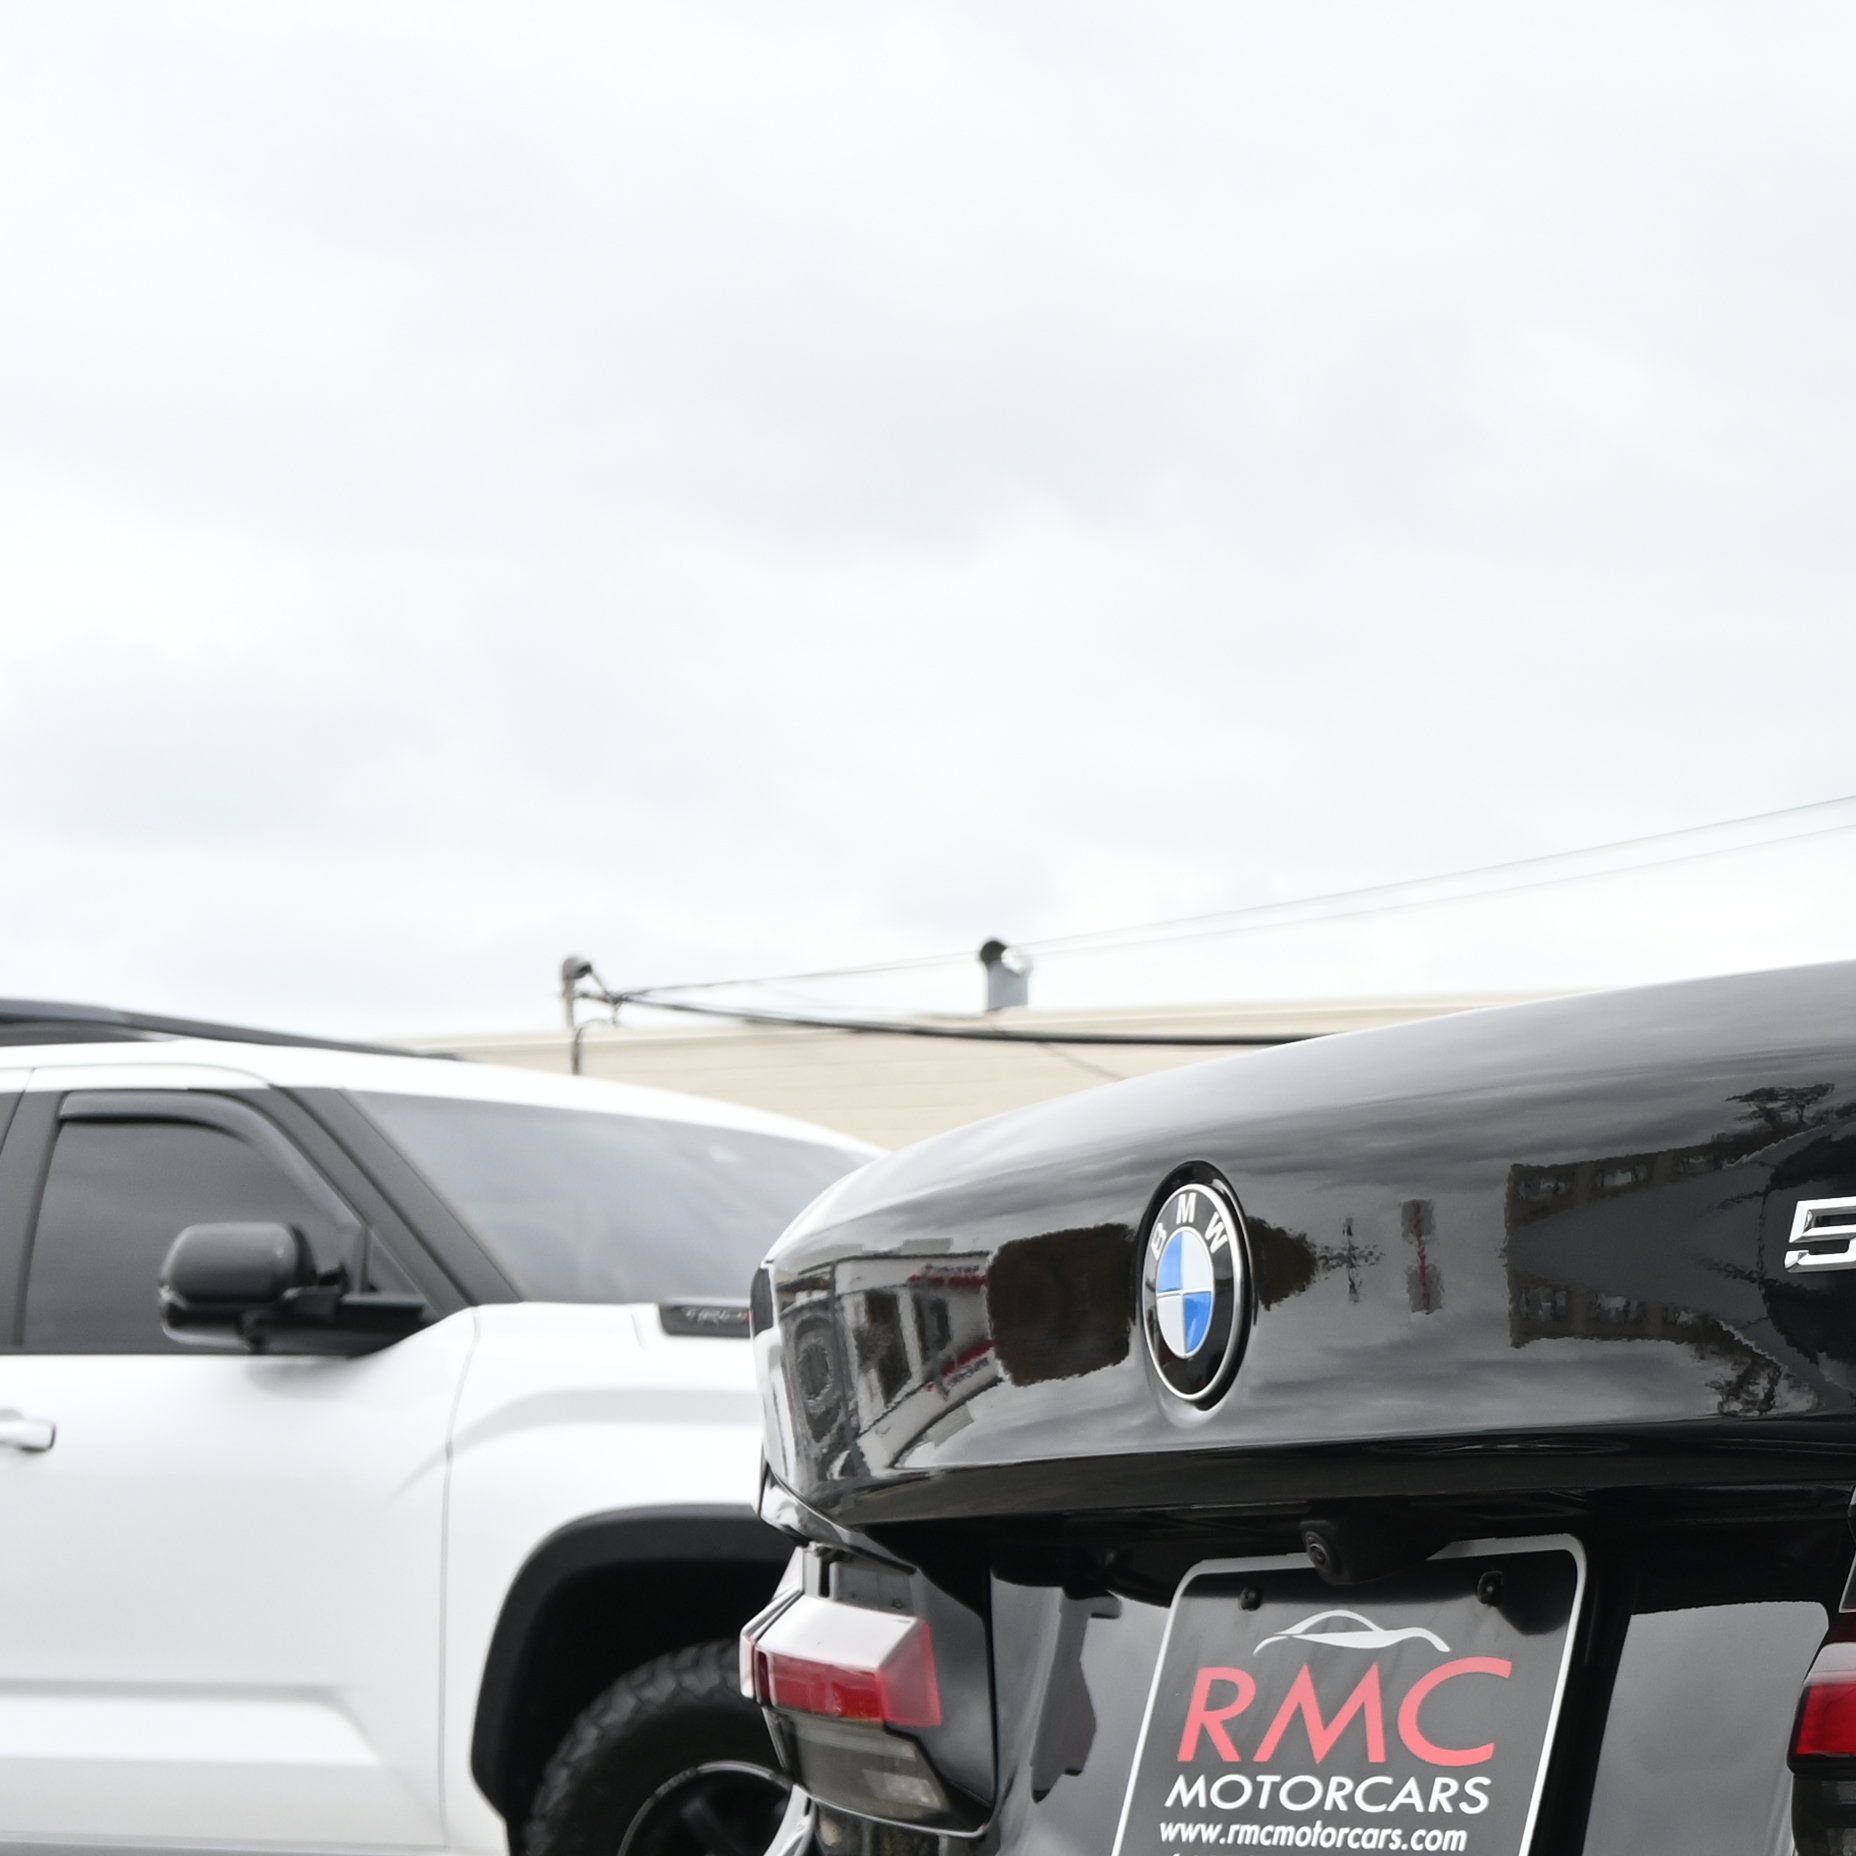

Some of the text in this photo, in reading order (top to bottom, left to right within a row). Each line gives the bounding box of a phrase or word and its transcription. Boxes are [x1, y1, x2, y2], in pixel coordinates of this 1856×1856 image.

[1150, 1192, 1228, 1261] BMW
[1177, 1656, 1513, 1767] RMC
[1164, 1774, 1492, 1815] MOTORCARS
[1159, 1819, 1468, 1852] www.rmcmotorcars.com
